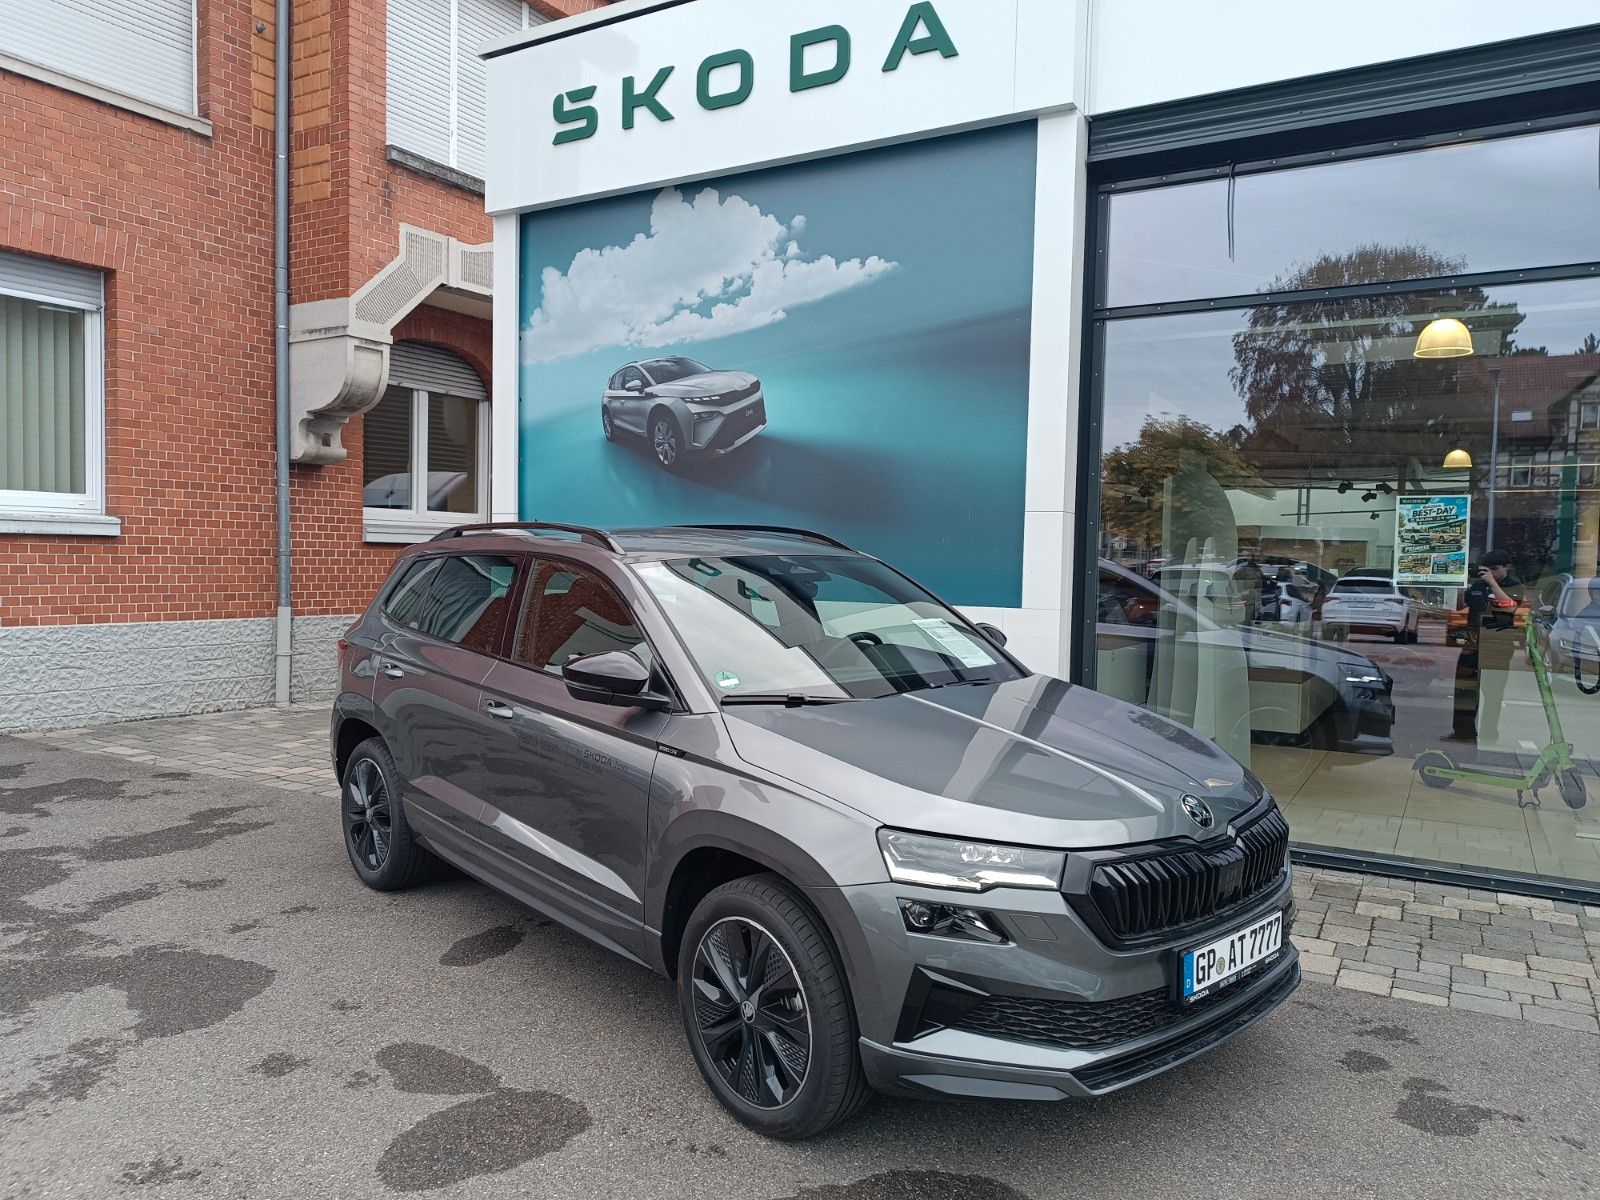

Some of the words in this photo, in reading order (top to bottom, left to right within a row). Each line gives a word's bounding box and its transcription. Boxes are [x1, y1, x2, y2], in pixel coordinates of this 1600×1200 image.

[1412, 507, 1456, 517] BEST-DAY
[583, 749, 612, 767] SKODA
[1196, 949, 1216, 984] GP
[1228, 934, 1246, 971] AT
[1250, 916, 1281, 959] 7777
